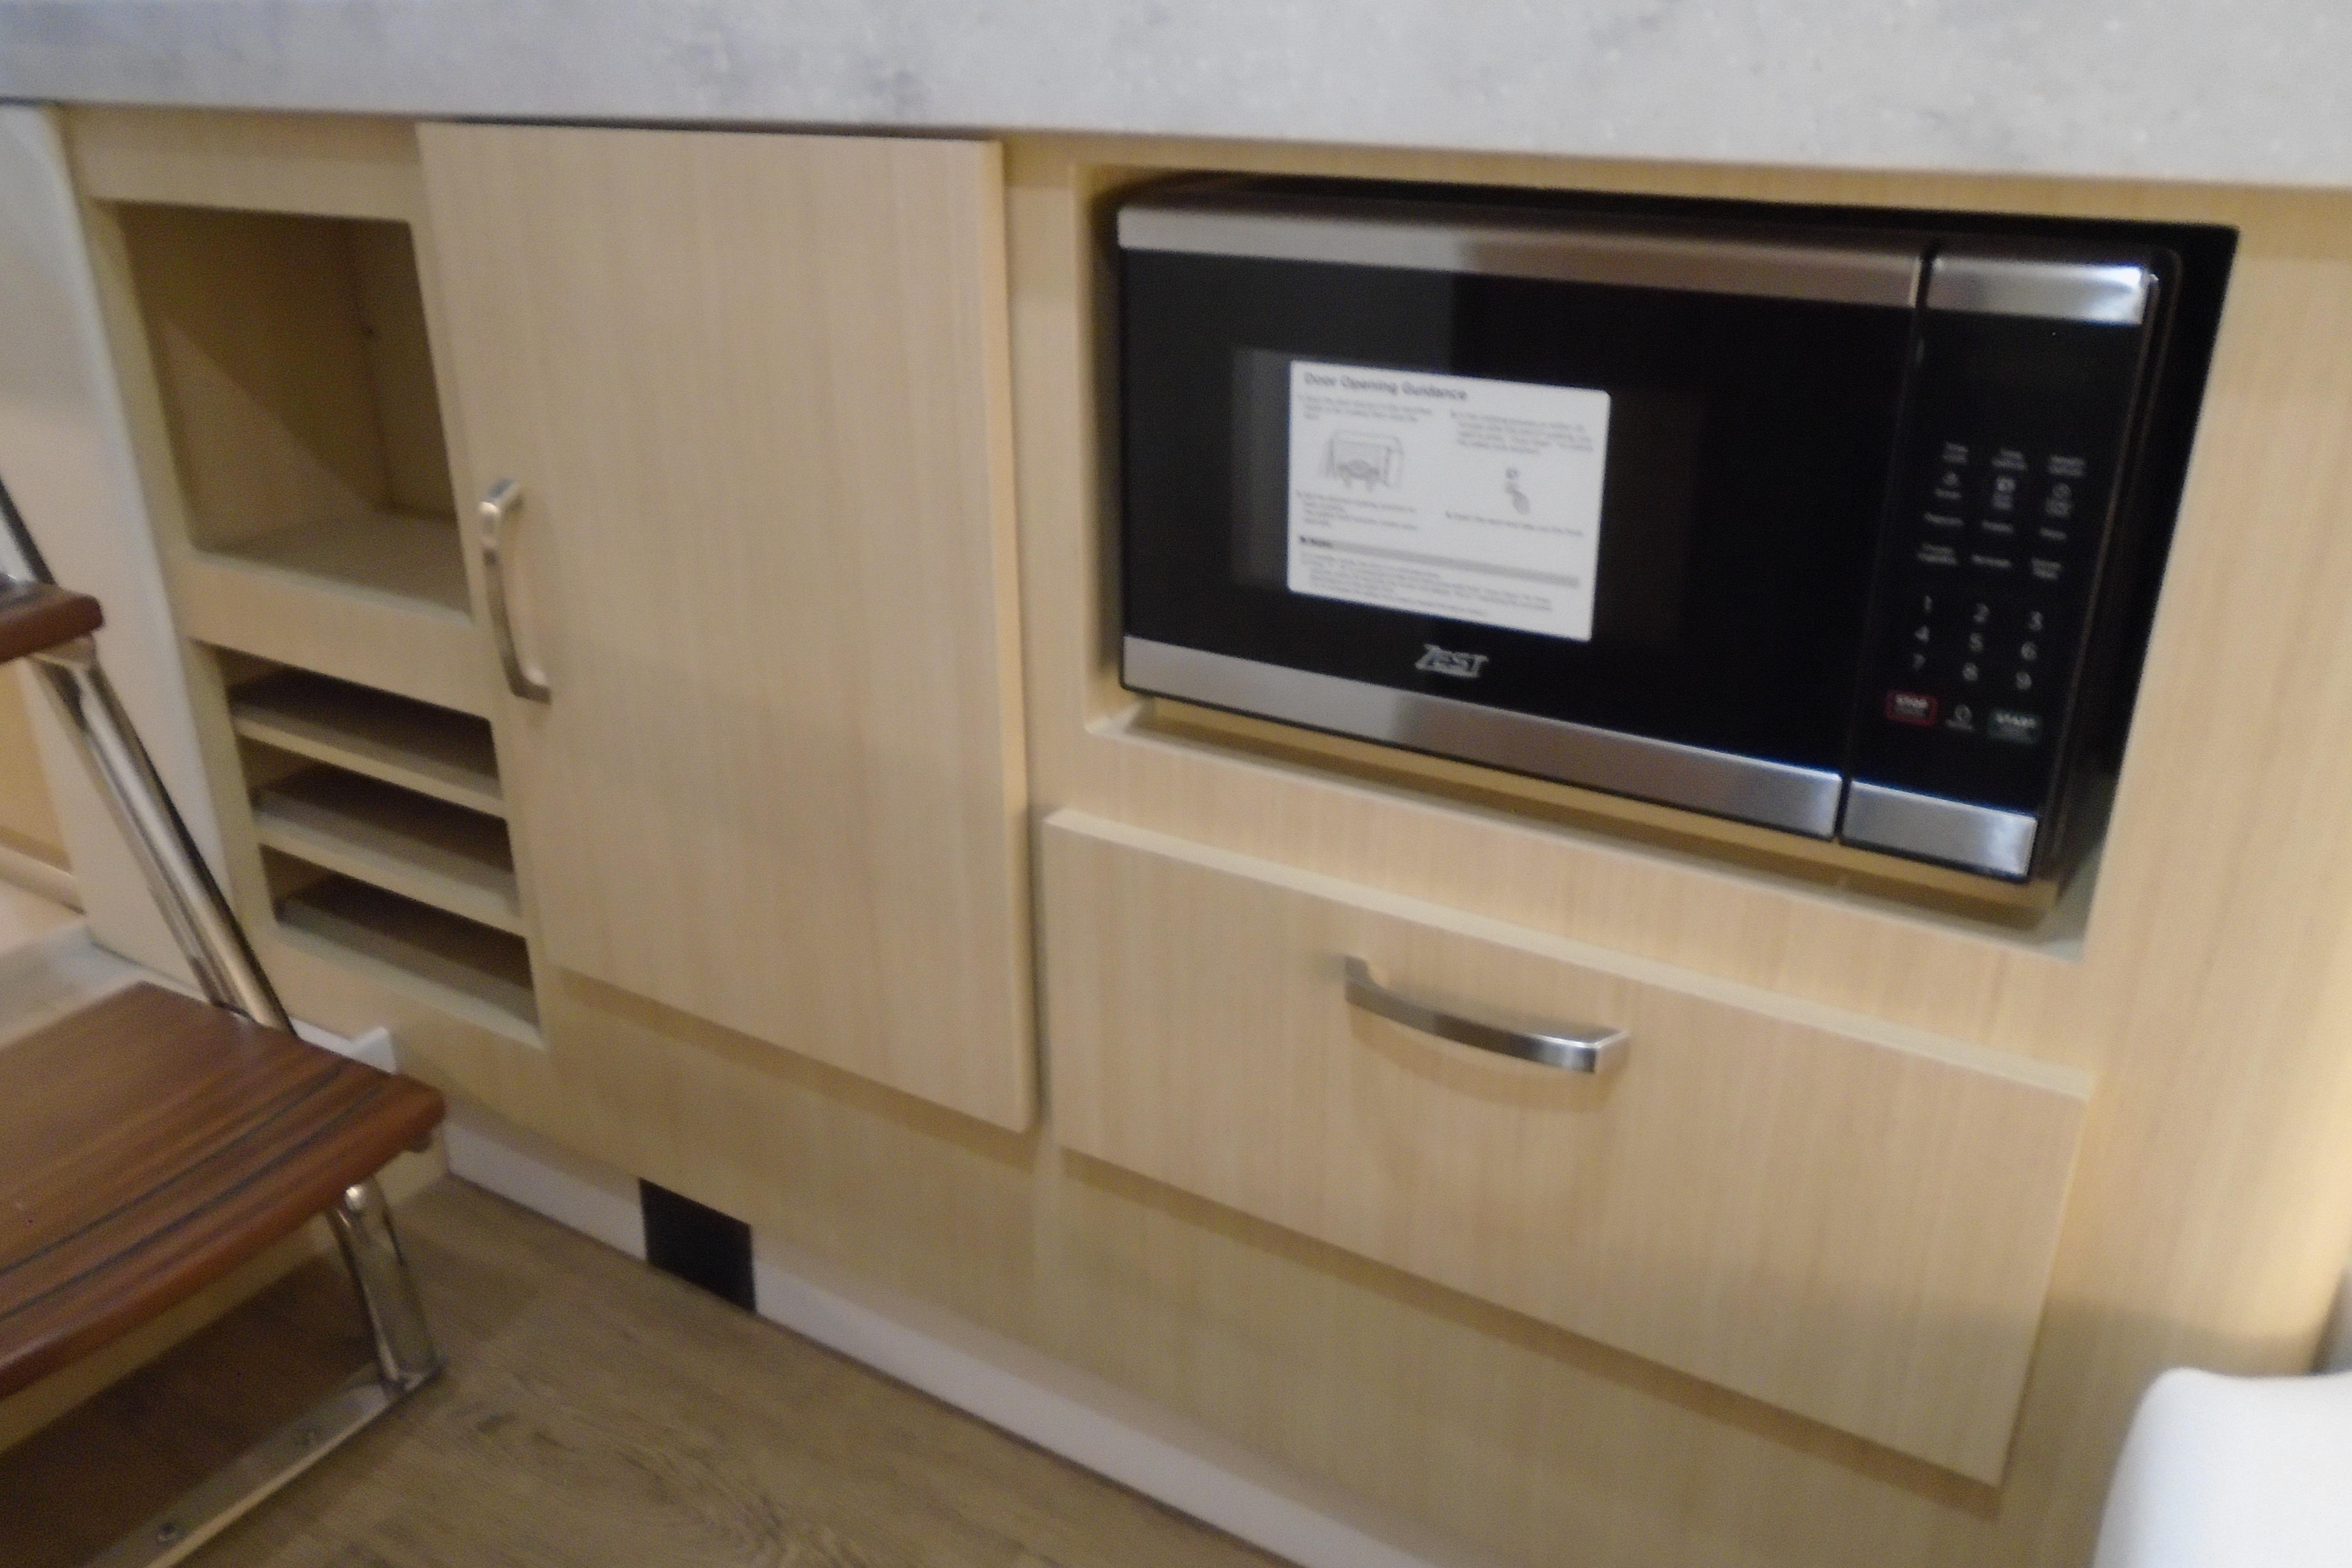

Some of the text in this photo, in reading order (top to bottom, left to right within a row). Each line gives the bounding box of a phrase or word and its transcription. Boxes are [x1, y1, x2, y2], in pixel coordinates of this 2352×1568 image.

[1304, 372, 1468, 400] Door Opening Guidance
[1923, 595, 1933, 613] 1
[1973, 603, 1990, 623] 2
[2028, 611, 2043, 632] 3
[1915, 625, 1930, 643] 4
[1969, 632, 1984, 652] 5
[1415, 644, 1489, 678] ZEST
[2020, 641, 2037, 661] 6
[1913, 653, 1926, 671] 7
[1962, 662, 1979, 682] 8
[2015, 671, 2032, 691] 9
[1895, 693, 1929, 709] STOP
